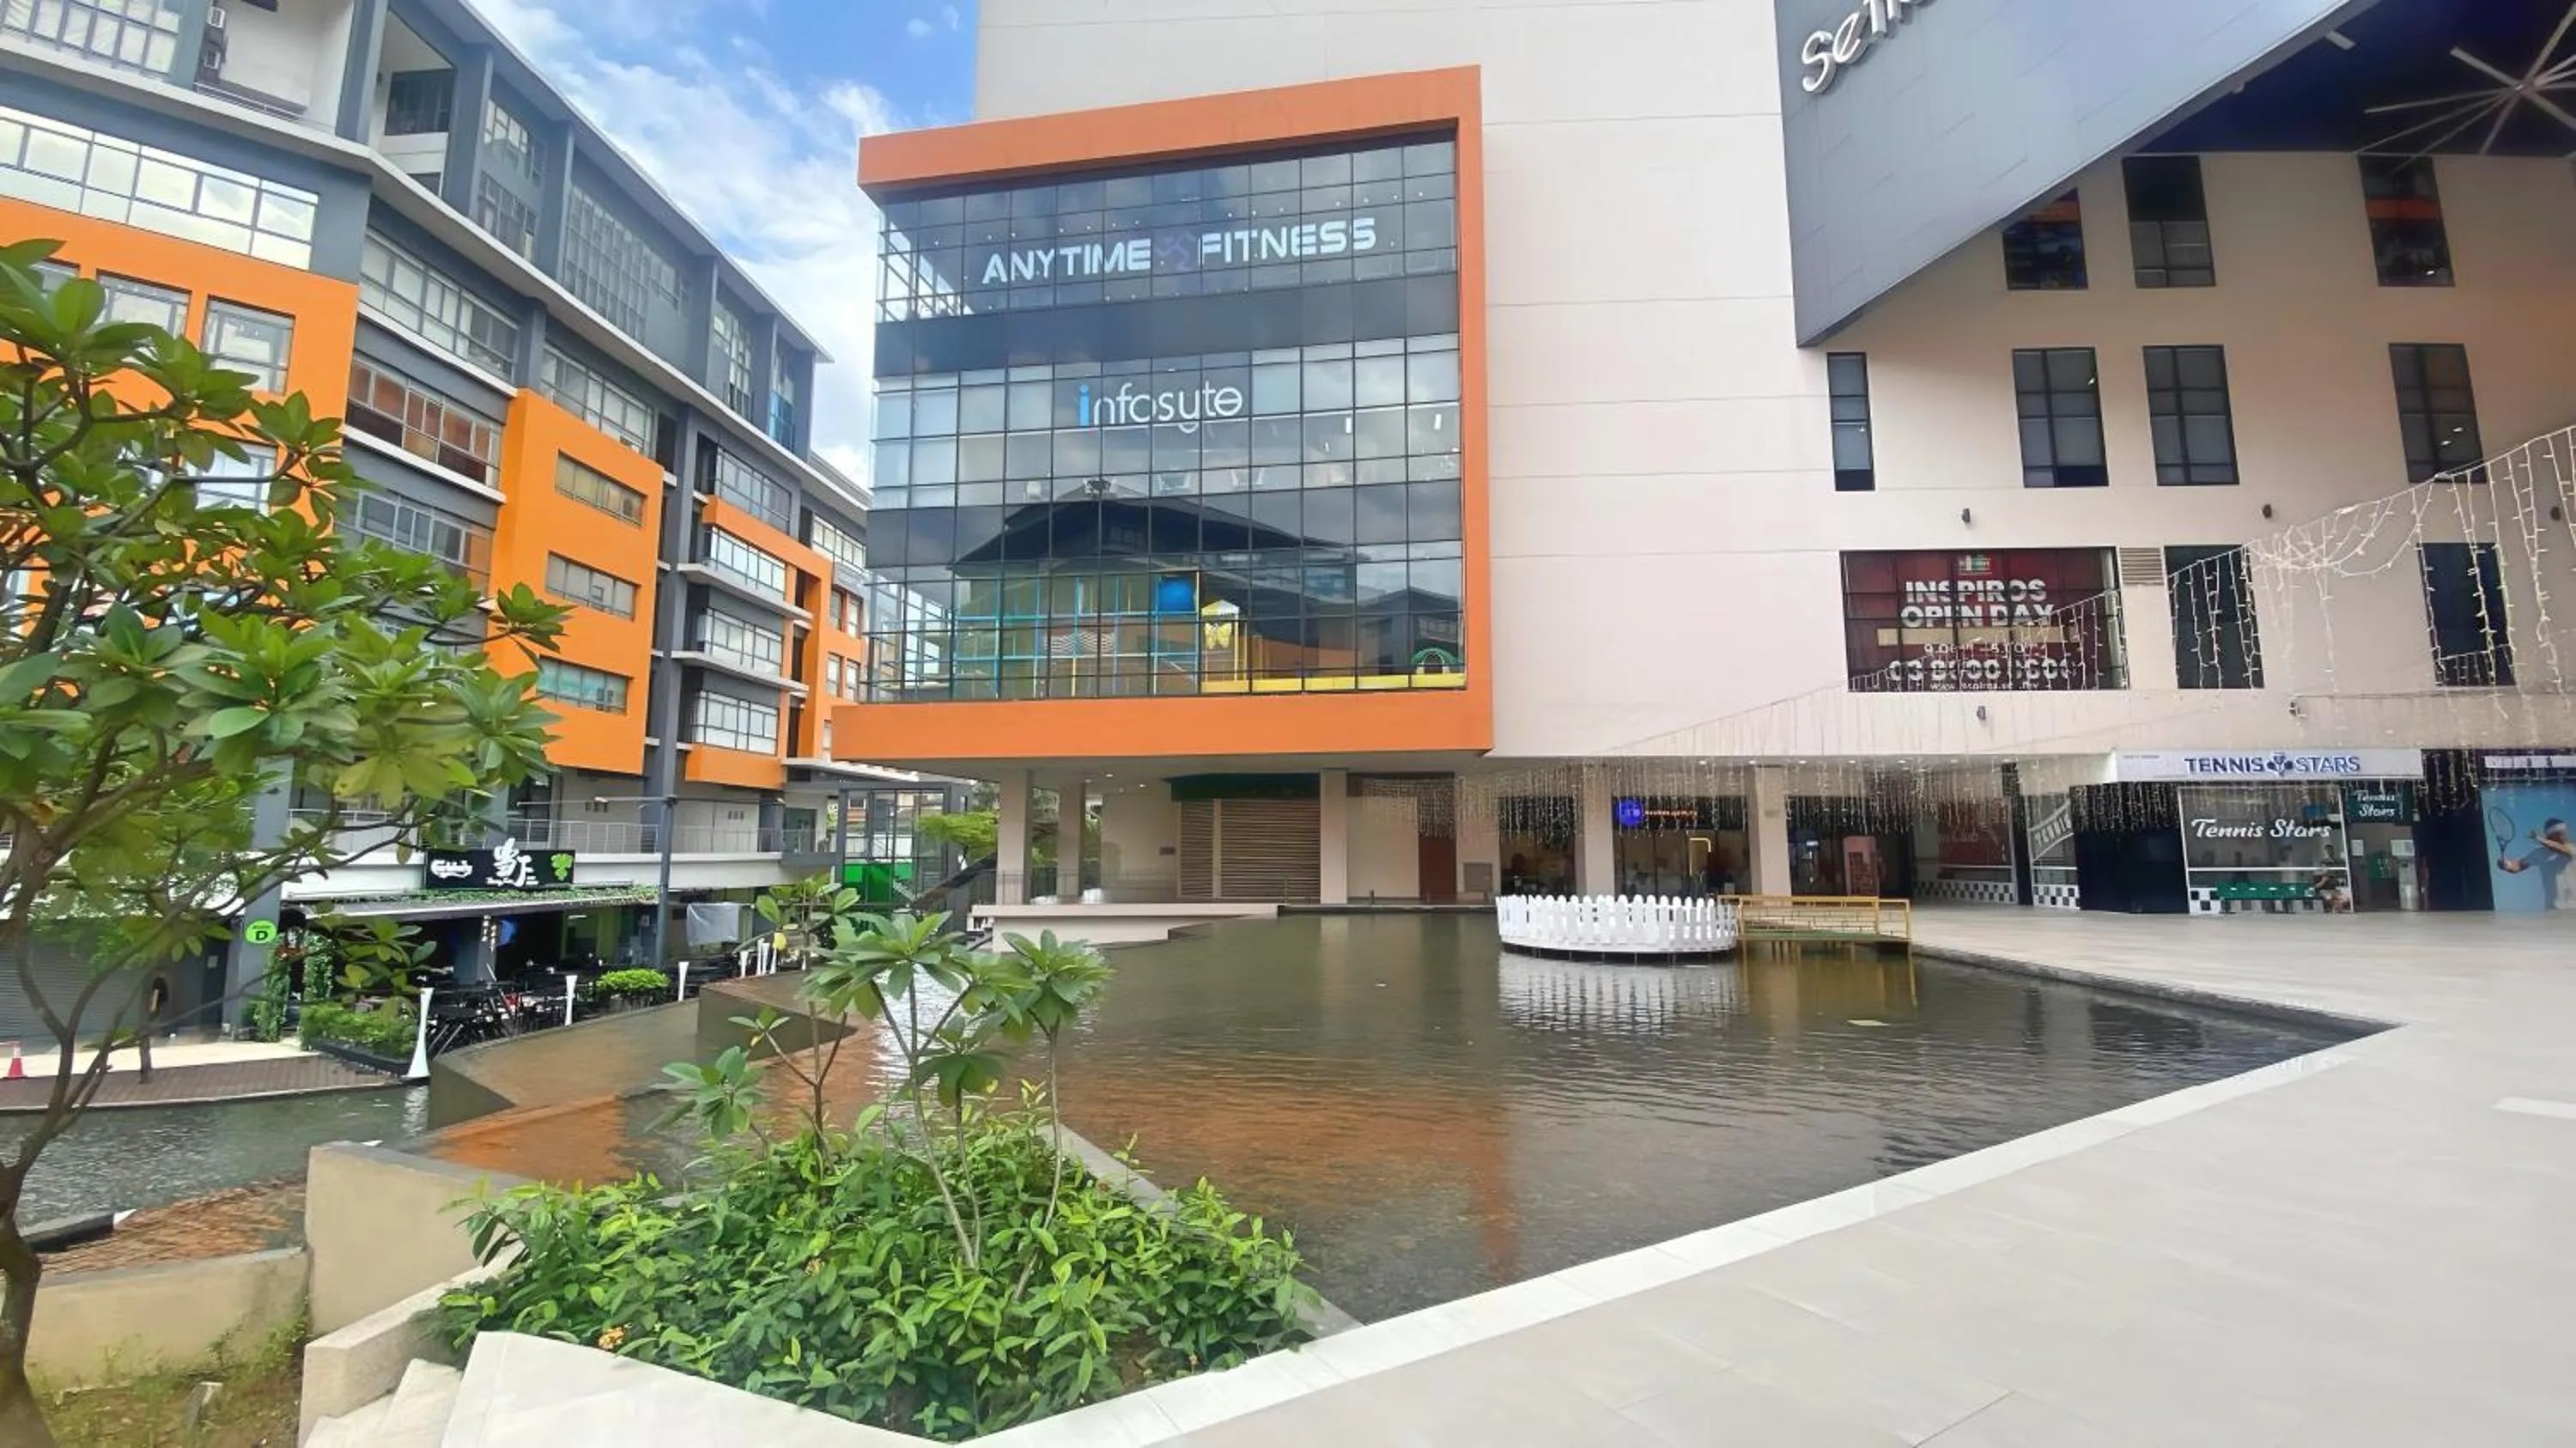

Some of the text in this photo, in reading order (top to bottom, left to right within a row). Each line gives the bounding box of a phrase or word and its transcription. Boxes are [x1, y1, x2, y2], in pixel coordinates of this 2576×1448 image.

[981, 217, 1376, 284] ANYTIME FITNESS
[1079, 380, 1243, 433] infosyte
[1905, 579, 2047, 603] INSPIROS
[1990, 604, 2054, 627] DAY
[2184, 756, 2361, 774] TENNIS STARS
[2359, 803, 2395, 817] Stars
[2191, 818, 2331, 838] Tennis Stars
[255, 930, 268, 941] D
